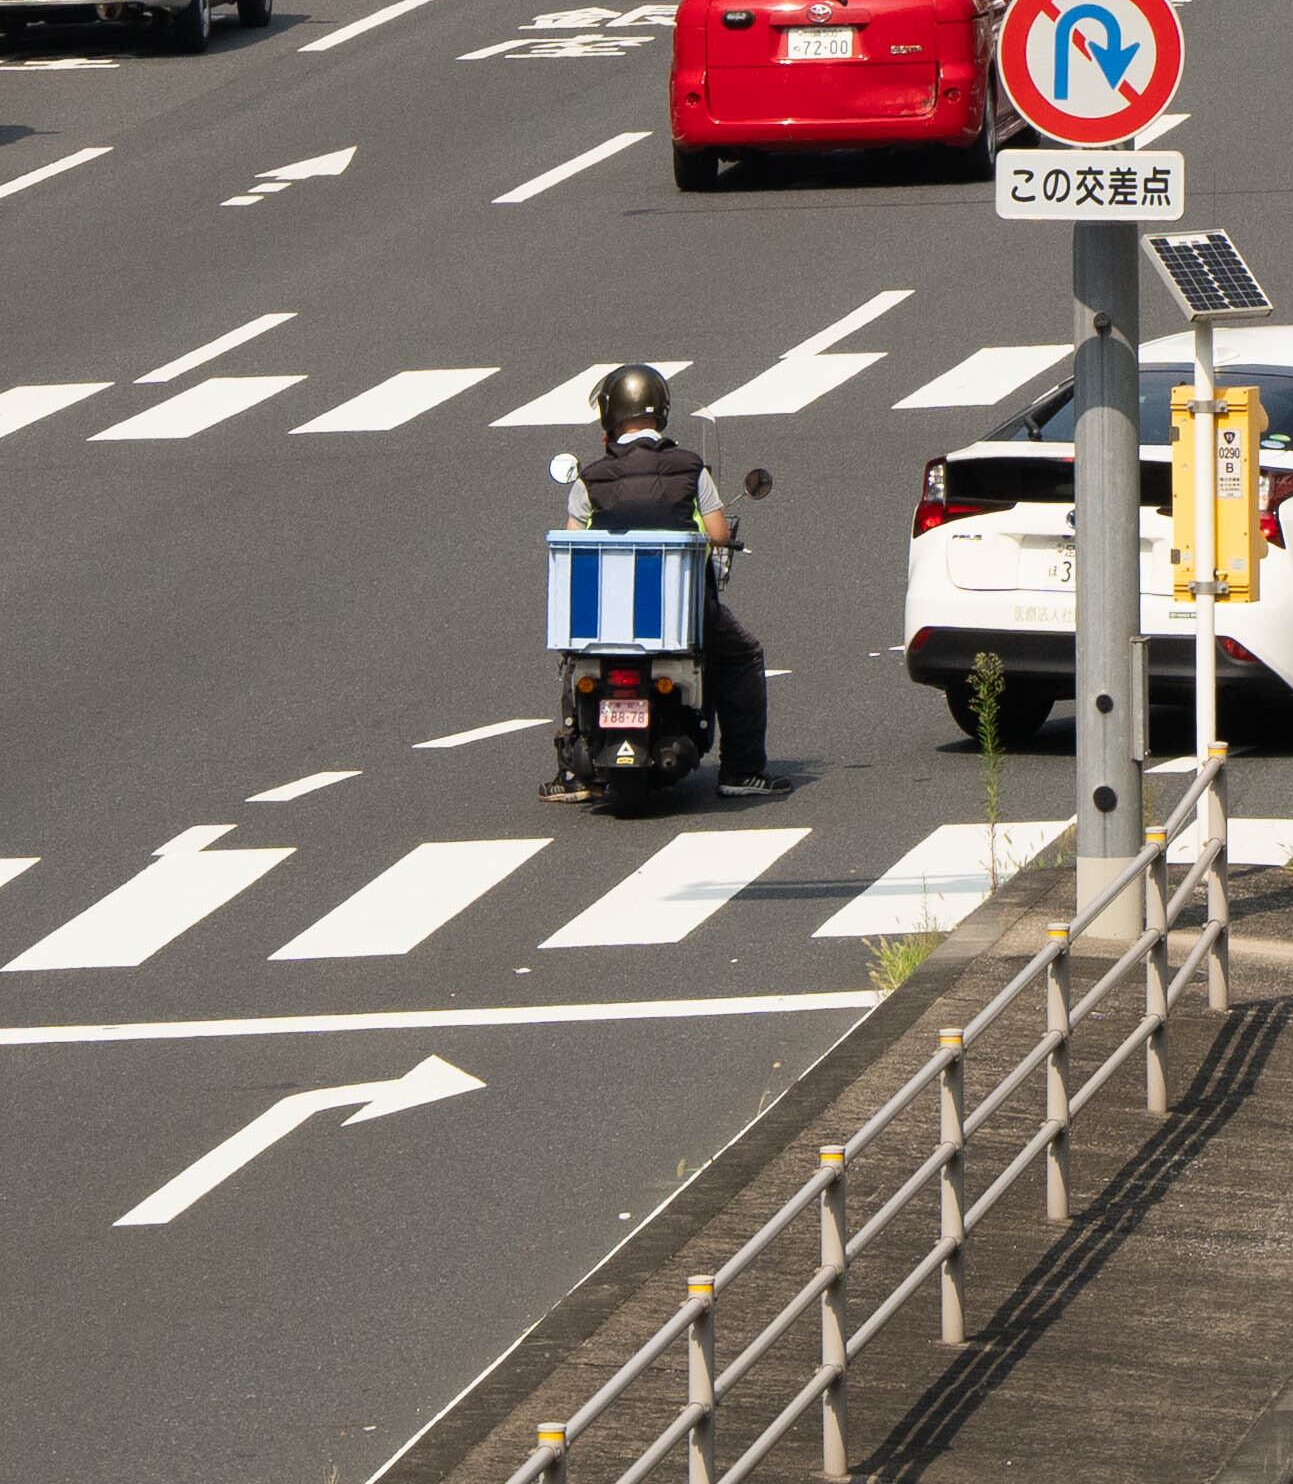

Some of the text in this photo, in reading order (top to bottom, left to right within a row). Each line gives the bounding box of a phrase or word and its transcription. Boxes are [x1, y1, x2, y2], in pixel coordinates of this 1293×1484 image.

[802, 40, 849, 56] 72-00
[1010, 166, 1172, 206] この交差点
[1218, 446, 1241, 460] 0290
[1225, 461, 1236, 474] B
